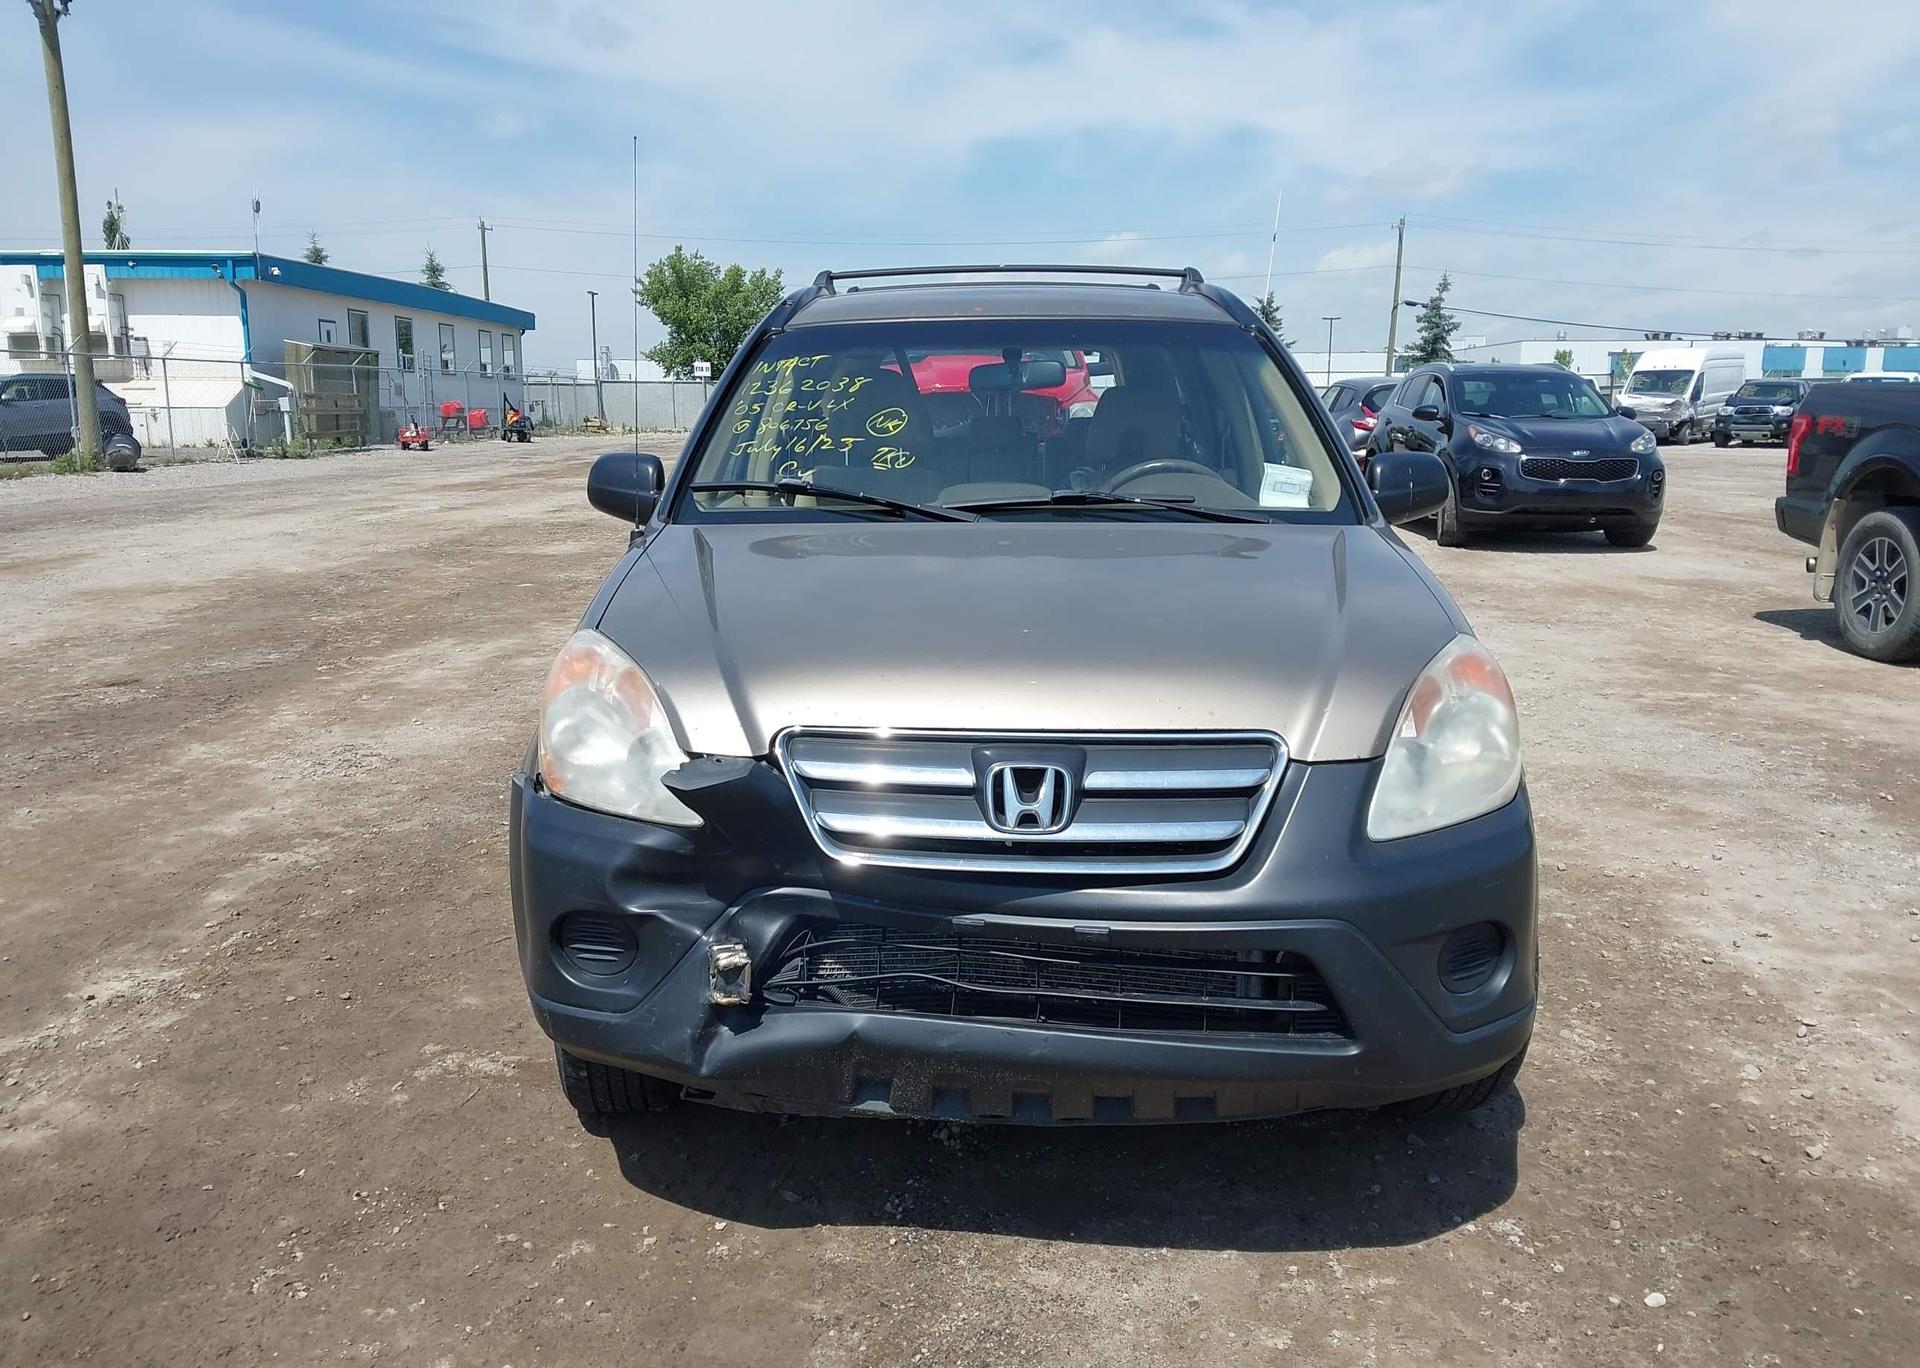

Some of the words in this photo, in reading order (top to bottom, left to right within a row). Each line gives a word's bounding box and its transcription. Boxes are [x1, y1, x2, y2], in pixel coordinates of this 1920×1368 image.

[752, 355, 832, 376] INTACT
[773, 400, 822, 412] CR-V
[730, 436, 782, 461] July
